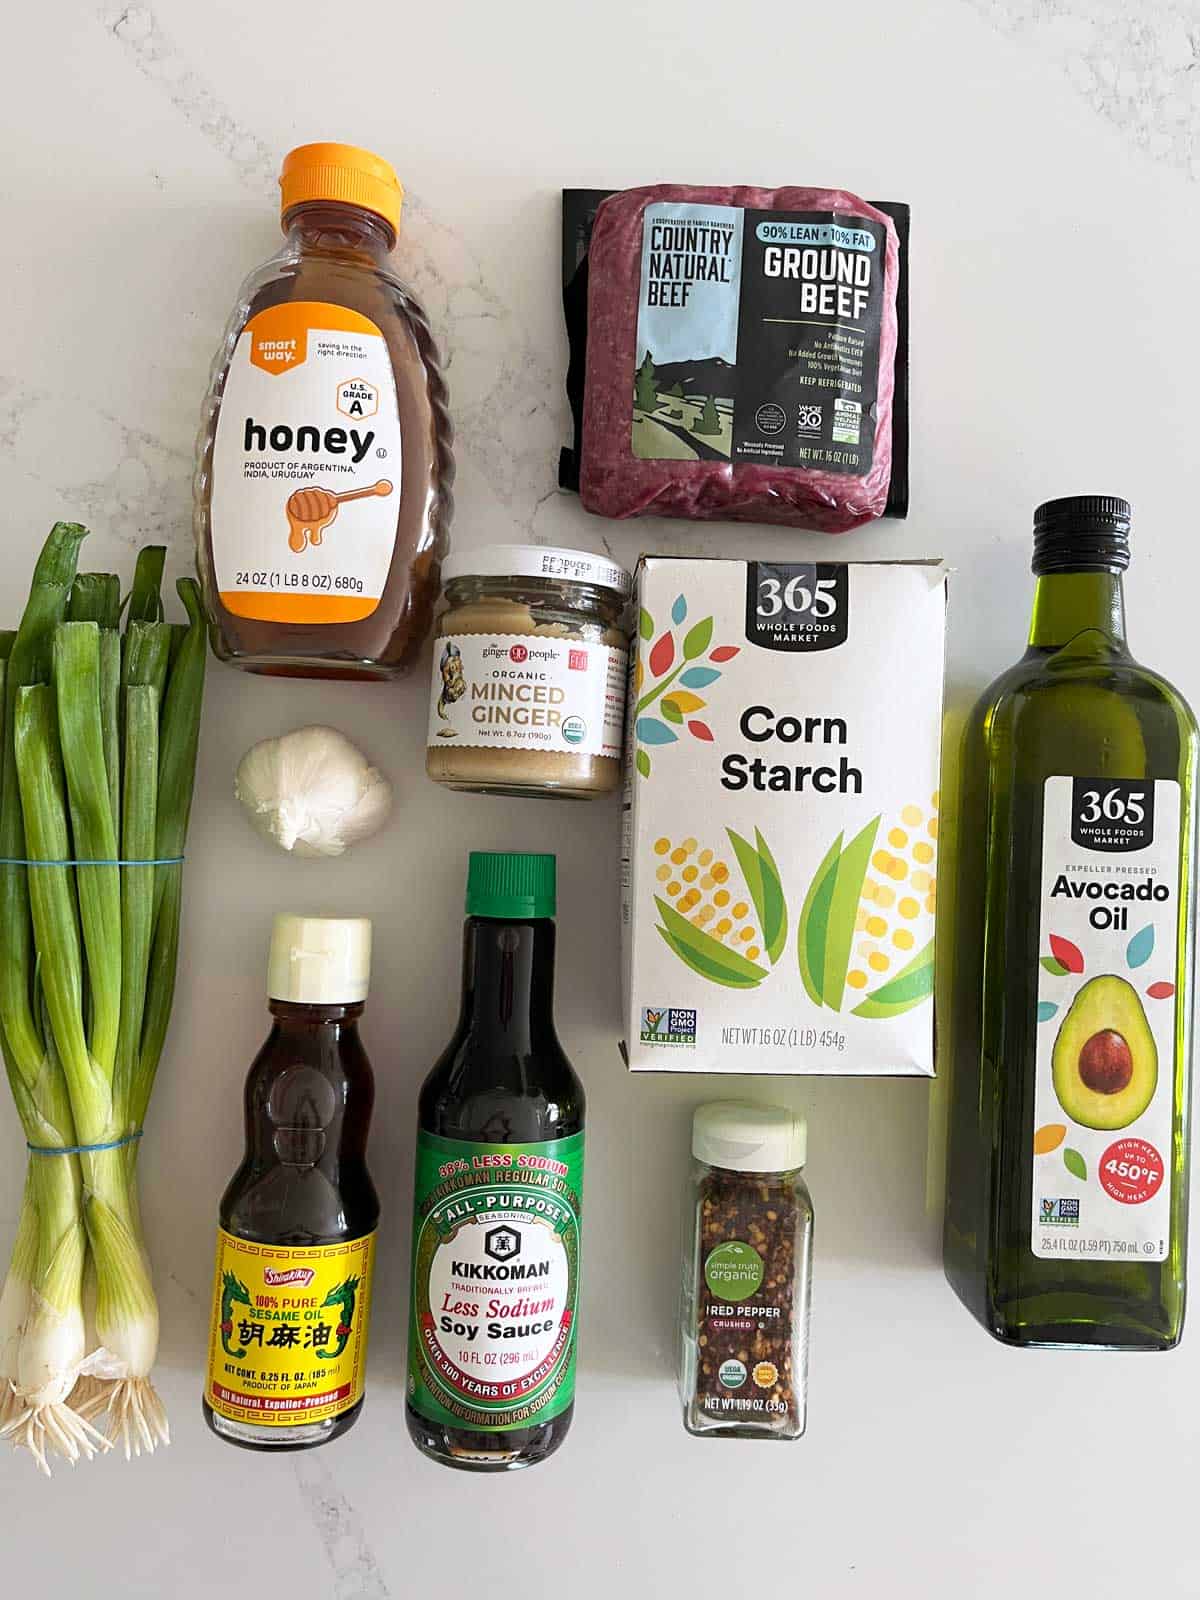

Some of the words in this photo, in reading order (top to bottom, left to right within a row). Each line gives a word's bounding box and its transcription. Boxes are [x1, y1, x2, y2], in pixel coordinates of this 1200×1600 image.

[651, 226, 734, 255] COUNTRY
[763, 226, 788, 239] 90%
[790, 227, 819, 241] LEAN
[831, 228, 850, 244] 10%
[852, 233, 871, 247] FAT
[649, 253, 730, 284] NATURAL
[764, 247, 871, 287] GROUND
[648, 280, 693, 307] BEEF
[800, 282, 867, 319] BEEF
[258, 340, 297, 351] smart
[318, 343, 341, 351] saving
[342, 343, 350, 351] in
[351, 344, 362, 352] the
[263, 351, 296, 363] way.
[317, 349, 335, 357] right
[336, 350, 368, 359] direction
[798, 349, 816, 359] Added
[350, 383, 367, 391] U.S.
[800, 376, 817, 385] KEEP
[818, 378, 862, 392] REFRIGERATED
[343, 391, 373, 400] GRADE
[349, 400, 363, 415] A
[799, 404, 823, 413] WHOLE
[798, 411, 822, 426] 30
[244, 418, 375, 463] honey
[800, 448, 811, 459] NET
[812, 449, 824, 460] WT.
[826, 450, 834, 461] 16
[834, 452, 841, 462] OZ
[842, 452, 848, 464] (1
[848, 453, 859, 465] LB)
[244, 462, 286, 471] PRODUCT
[287, 463, 300, 471] OF
[300, 464, 356, 474] ARGENTINA,
[244, 470, 270, 479] INDIA,
[271, 471, 315, 480] URUGUAY
[236, 573, 249, 585] 24
[252, 573, 267, 585] OZ
[270, 574, 280, 588] (1
[284, 575, 299, 587] LB
[301, 575, 309, 587] 8
[312, 575, 332, 590] OZ)
[335, 577, 363, 593] 680g
[756, 574, 837, 618] 365
[756, 623, 796, 633] WHOLE
[799, 623, 837, 633] FOODS
[773, 633, 819, 643] MARKET
[482, 646, 509, 659] ginger
[528, 649, 558, 661] people
[492, 670, 547, 681] ORGANIC
[471, 683, 566, 705] MINCED
[471, 705, 563, 728] GINGER
[739, 705, 848, 745] Corn
[493, 730, 504, 738] Wt.
[506, 730, 527, 739] 6.7oz
[528, 731, 552, 741] (190g)
[720, 753, 863, 794] Starch
[1079, 787, 1145, 825] 365
[1080, 828, 1112, 836] WHOLE
[1114, 829, 1145, 837] FOODS
[1093, 837, 1131, 845] MARKET
[1065, 864, 1112, 873] EXPELLER
[1115, 866, 1158, 875] PRESSED
[1050, 875, 1170, 902] Avocado
[1089, 906, 1128, 931] Oil
[671, 1010, 695, 1019] NON
[671, 1019, 695, 1027] GMO
[643, 1033, 694, 1042] VERIFIED
[722, 1027, 740, 1044] NET
[742, 1028, 757, 1045] WT
[759, 1028, 771, 1045] 16
[773, 1028, 786, 1046] OZ
[788, 1027, 797, 1048] (1
[800, 1028, 817, 1048] LB)
[819, 1030, 845, 1051] 454g
[1118, 1141, 1139, 1150] HIGH
[1141, 1145, 1160, 1162] HEAT
[438, 1159, 469, 1177] 38%
[473, 1155, 512, 1168] LESS
[517, 1155, 568, 1177] SODIUM
[1136, 1155, 1146, 1164] TO
[495, 1170, 549, 1187] REGULAR
[1104, 1159, 1159, 1185] 450°F
[1106, 1182, 1125, 1199] HIGH
[1127, 1190, 1147, 1201] HEAT
[478, 1212, 532, 1222] SEASONING
[1041, 1238, 1058, 1250] 25.4
[1060, 1239, 1067, 1251] FL
[1068, 1240, 1078, 1251] OZ
[1080, 1239, 1098, 1252] (1.59
[1099, 1240, 1112, 1254] PT)
[1112, 1241, 1127, 1252] 750
[1128, 1241, 1138, 1253] mL
[451, 1260, 549, 1281] KIKKOMAN
[738, 1262, 759, 1271] truth
[710, 1270, 760, 1281] organic
[451, 1282, 514, 1295] TRADITIONALLY
[255, 1295, 279, 1308] 100%
[282, 1297, 318, 1308] PURE
[440, 1293, 480, 1318] Less
[486, 1296, 555, 1319] Sodium
[249, 1308, 300, 1321] SESAME
[304, 1309, 324, 1321] OIL
[711, 1305, 734, 1316] RED
[737, 1306, 781, 1318] PEPPER
[440, 1316, 480, 1341] Soy
[487, 1319, 553, 1340] Sauce
[713, 1320, 751, 1328] CRUSHED
[237, 1319, 333, 1349] 胡麻油
[424, 1328, 442, 1361] OVER
[441, 1361, 460, 1381] 300
[461, 1376, 499, 1397] YEARS
[502, 1383, 518, 1396] OF
[520, 1325, 569, 1389] EXCELLENCE
[458, 1351, 468, 1362] 10
[471, 1352, 481, 1364] FL
[484, 1353, 497, 1365] OZ
[500, 1352, 520, 1366] (296
[523, 1348, 540, 1362] mL)
[224, 1363, 235, 1374] NET
[236, 1367, 257, 1380] CONT.
[261, 1372, 279, 1382] 6.25
[308, 1369, 326, 1380] (185
[242, 1380, 277, 1390] PRODUCT
[280, 1382, 291, 1390] OF
[294, 1381, 318, 1390] JAPAN
[221, 1389, 230, 1400] All
[264, 1390, 338, 1410] Expeller-Pressed
[451, 1400, 511, 1426] INFORMATION
[512, 1407, 530, 1421] FOR
[530, 1383, 557, 1413] SODIUM
[704, 1397, 719, 1409] NET
[721, 1398, 734, 1410] WT
[736, 1399, 751, 1410] 1.19
[753, 1399, 763, 1410] OZ
